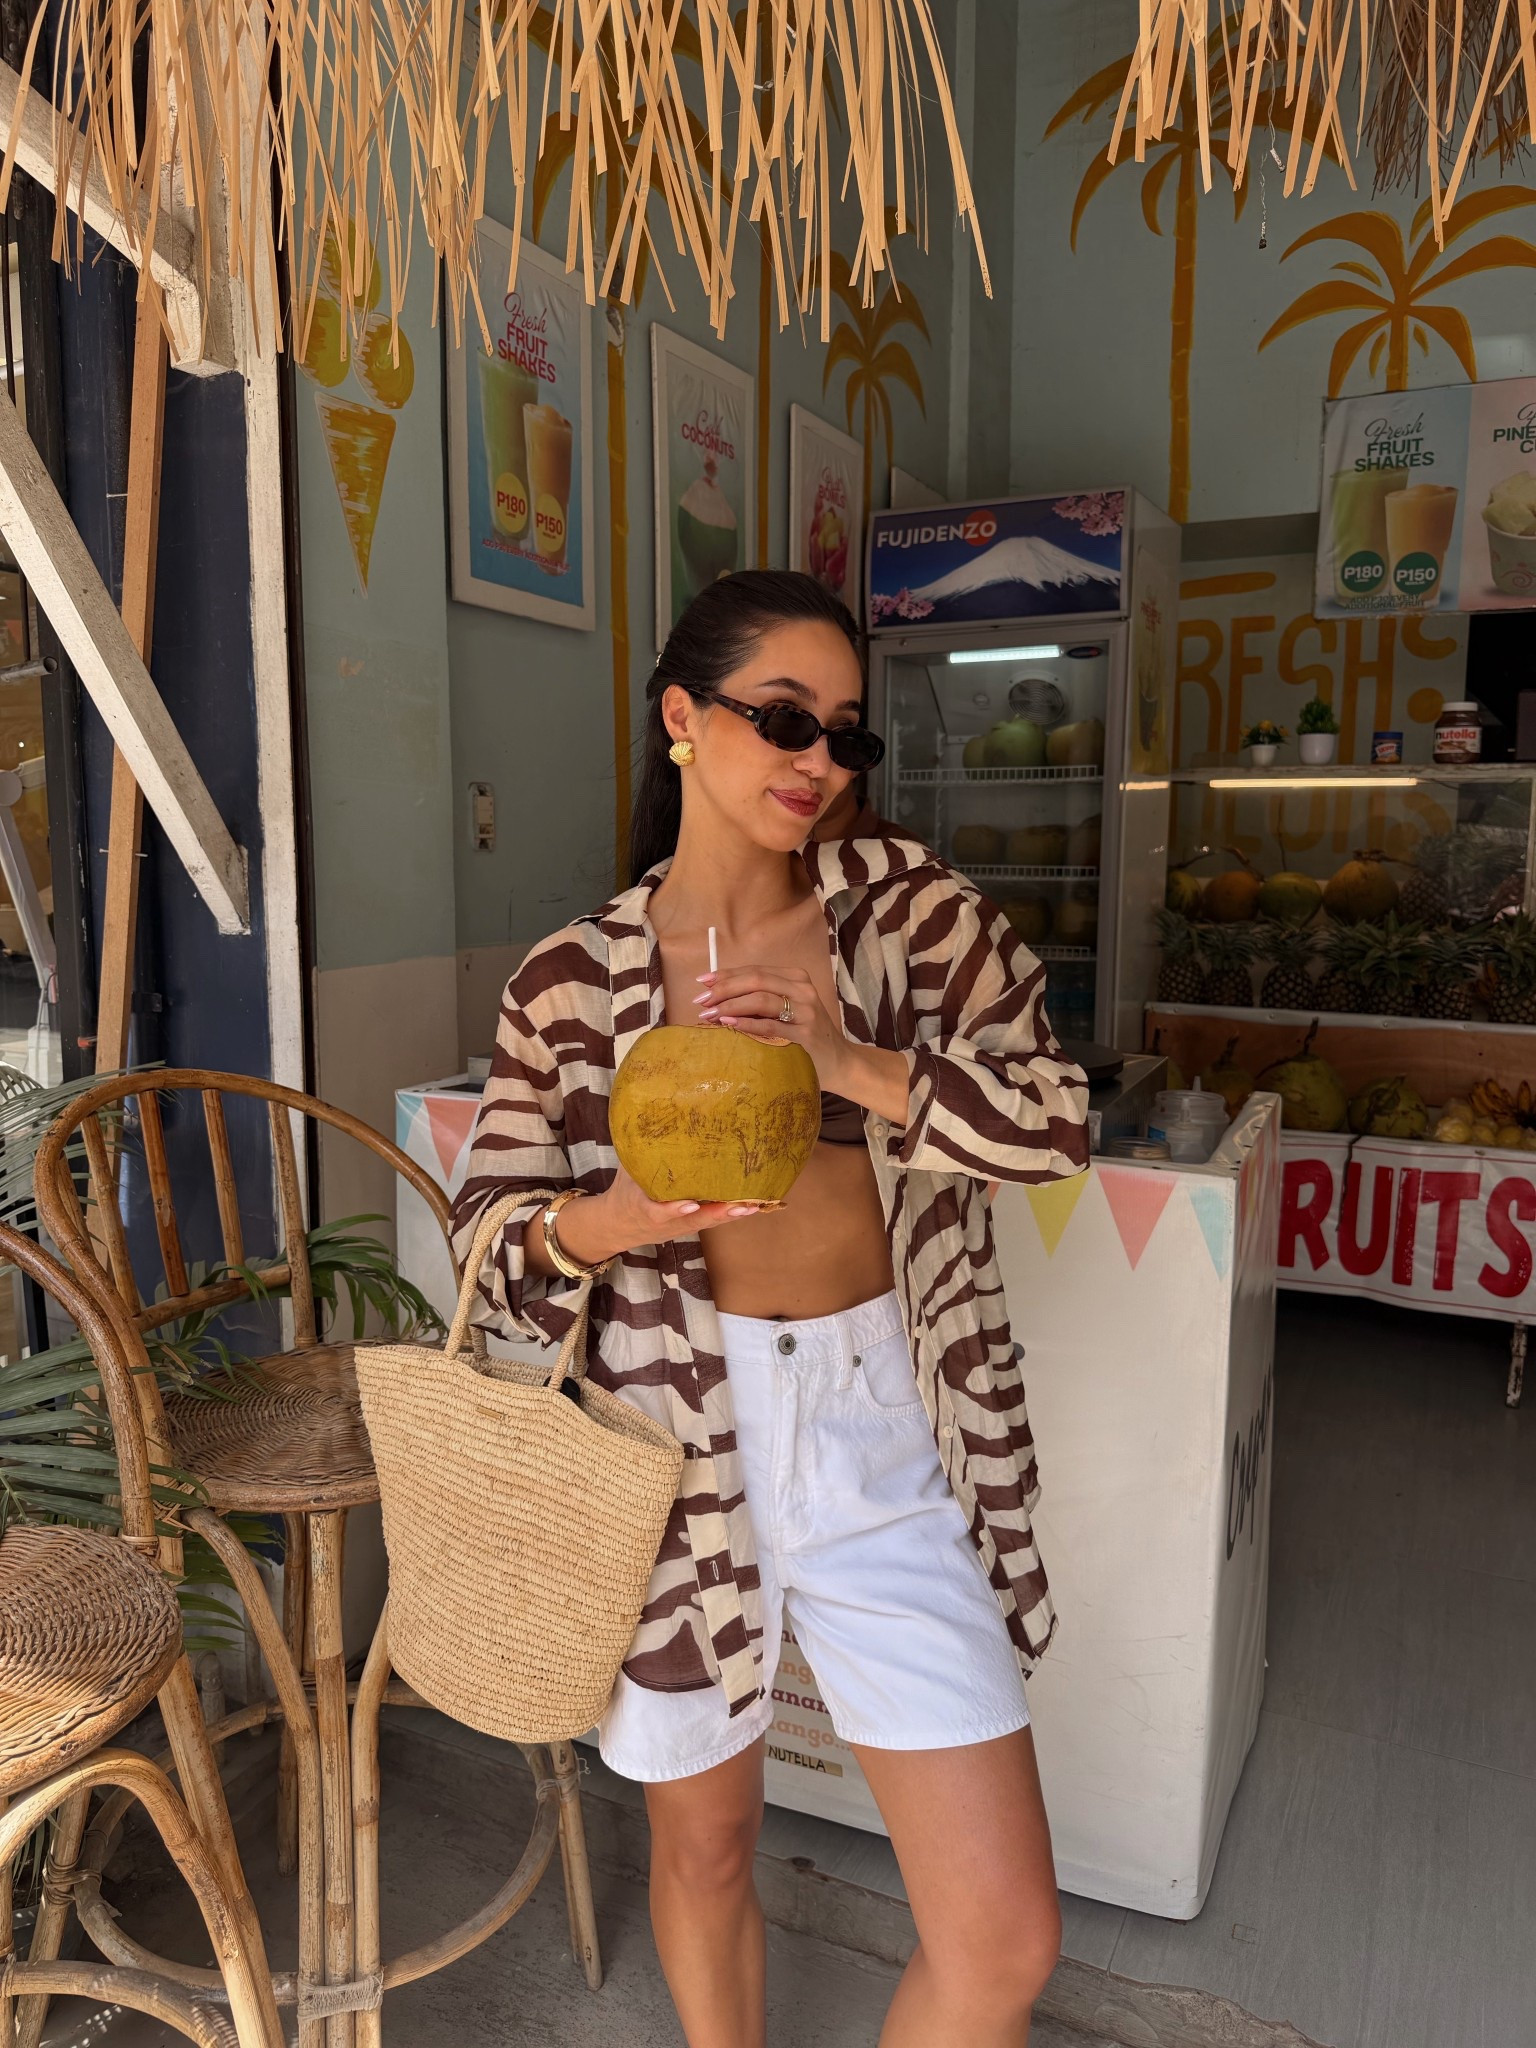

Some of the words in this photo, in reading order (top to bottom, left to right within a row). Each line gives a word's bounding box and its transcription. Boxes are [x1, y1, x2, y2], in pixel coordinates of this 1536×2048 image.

[504, 292, 547, 333] Fresh
[506, 322, 548, 359] FRUIT
[498, 338, 556, 383] SHAKES
[682, 423, 735, 460] COCONUTS
[1364, 413, 1424, 444] Fresh
[1354, 451, 1435, 473] SHAKES
[1366, 438, 1424, 457] FRUIT
[496, 490, 526, 516] P180
[536, 512, 563, 536] P150
[877, 519, 997, 549] FUJIDENZO
[1344, 564, 1383, 580] P180
[1396, 567, 1436, 583] P150
[1435, 728, 1477, 741] nutella
[1276, 1158, 1536, 1299] RUITS
[768, 1744, 827, 1774] NUTELLA
